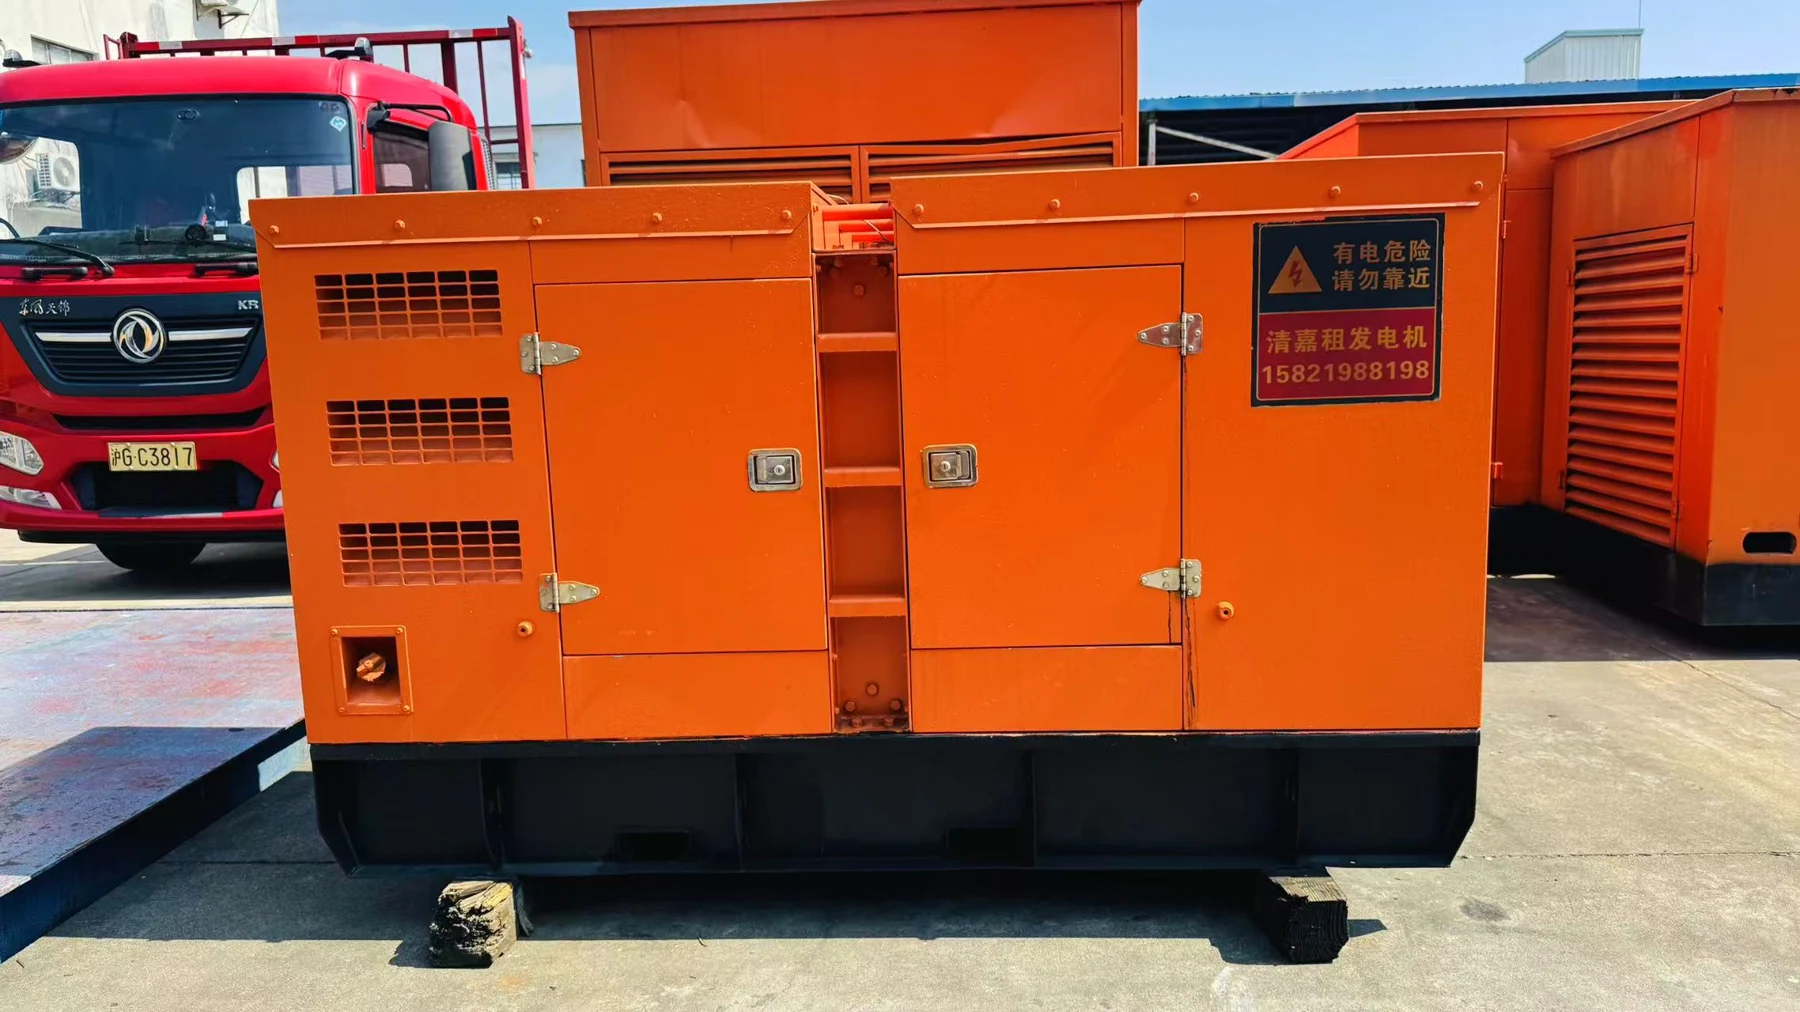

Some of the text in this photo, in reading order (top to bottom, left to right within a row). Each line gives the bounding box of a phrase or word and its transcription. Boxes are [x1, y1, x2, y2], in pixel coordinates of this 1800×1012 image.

[1333, 239, 1431, 264] 有电危险
[1332, 267, 1431, 291] 请勿靠近
[237, 299, 259, 310] KR
[1266, 325, 1427, 354] 清嘉租发电机
[1262, 360, 1429, 384] 15821988198
